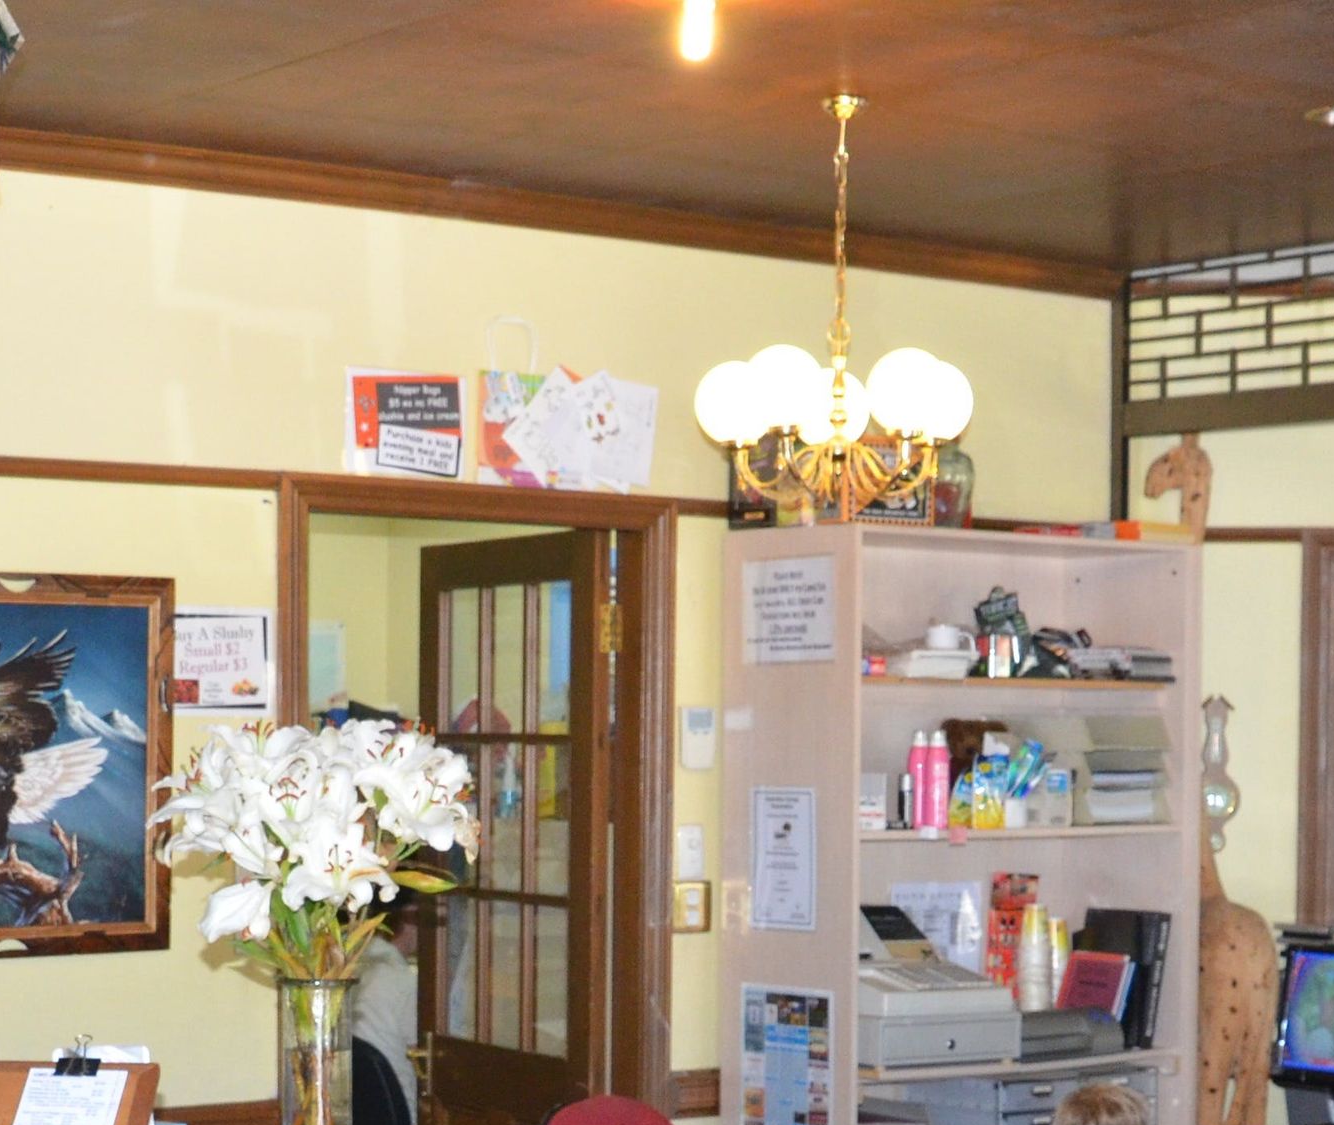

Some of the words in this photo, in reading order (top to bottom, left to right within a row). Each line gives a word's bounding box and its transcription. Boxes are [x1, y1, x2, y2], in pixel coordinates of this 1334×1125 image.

[427, 397, 448, 408] FREE
[407, 411, 422, 420] and
[387, 429, 424, 442] Purchase
[428, 459, 449, 469] FREE
[198, 627, 209, 640] A
[213, 624, 255, 641] Slushy
[184, 642, 223, 658] Small
[179, 660, 229, 676] Regular
